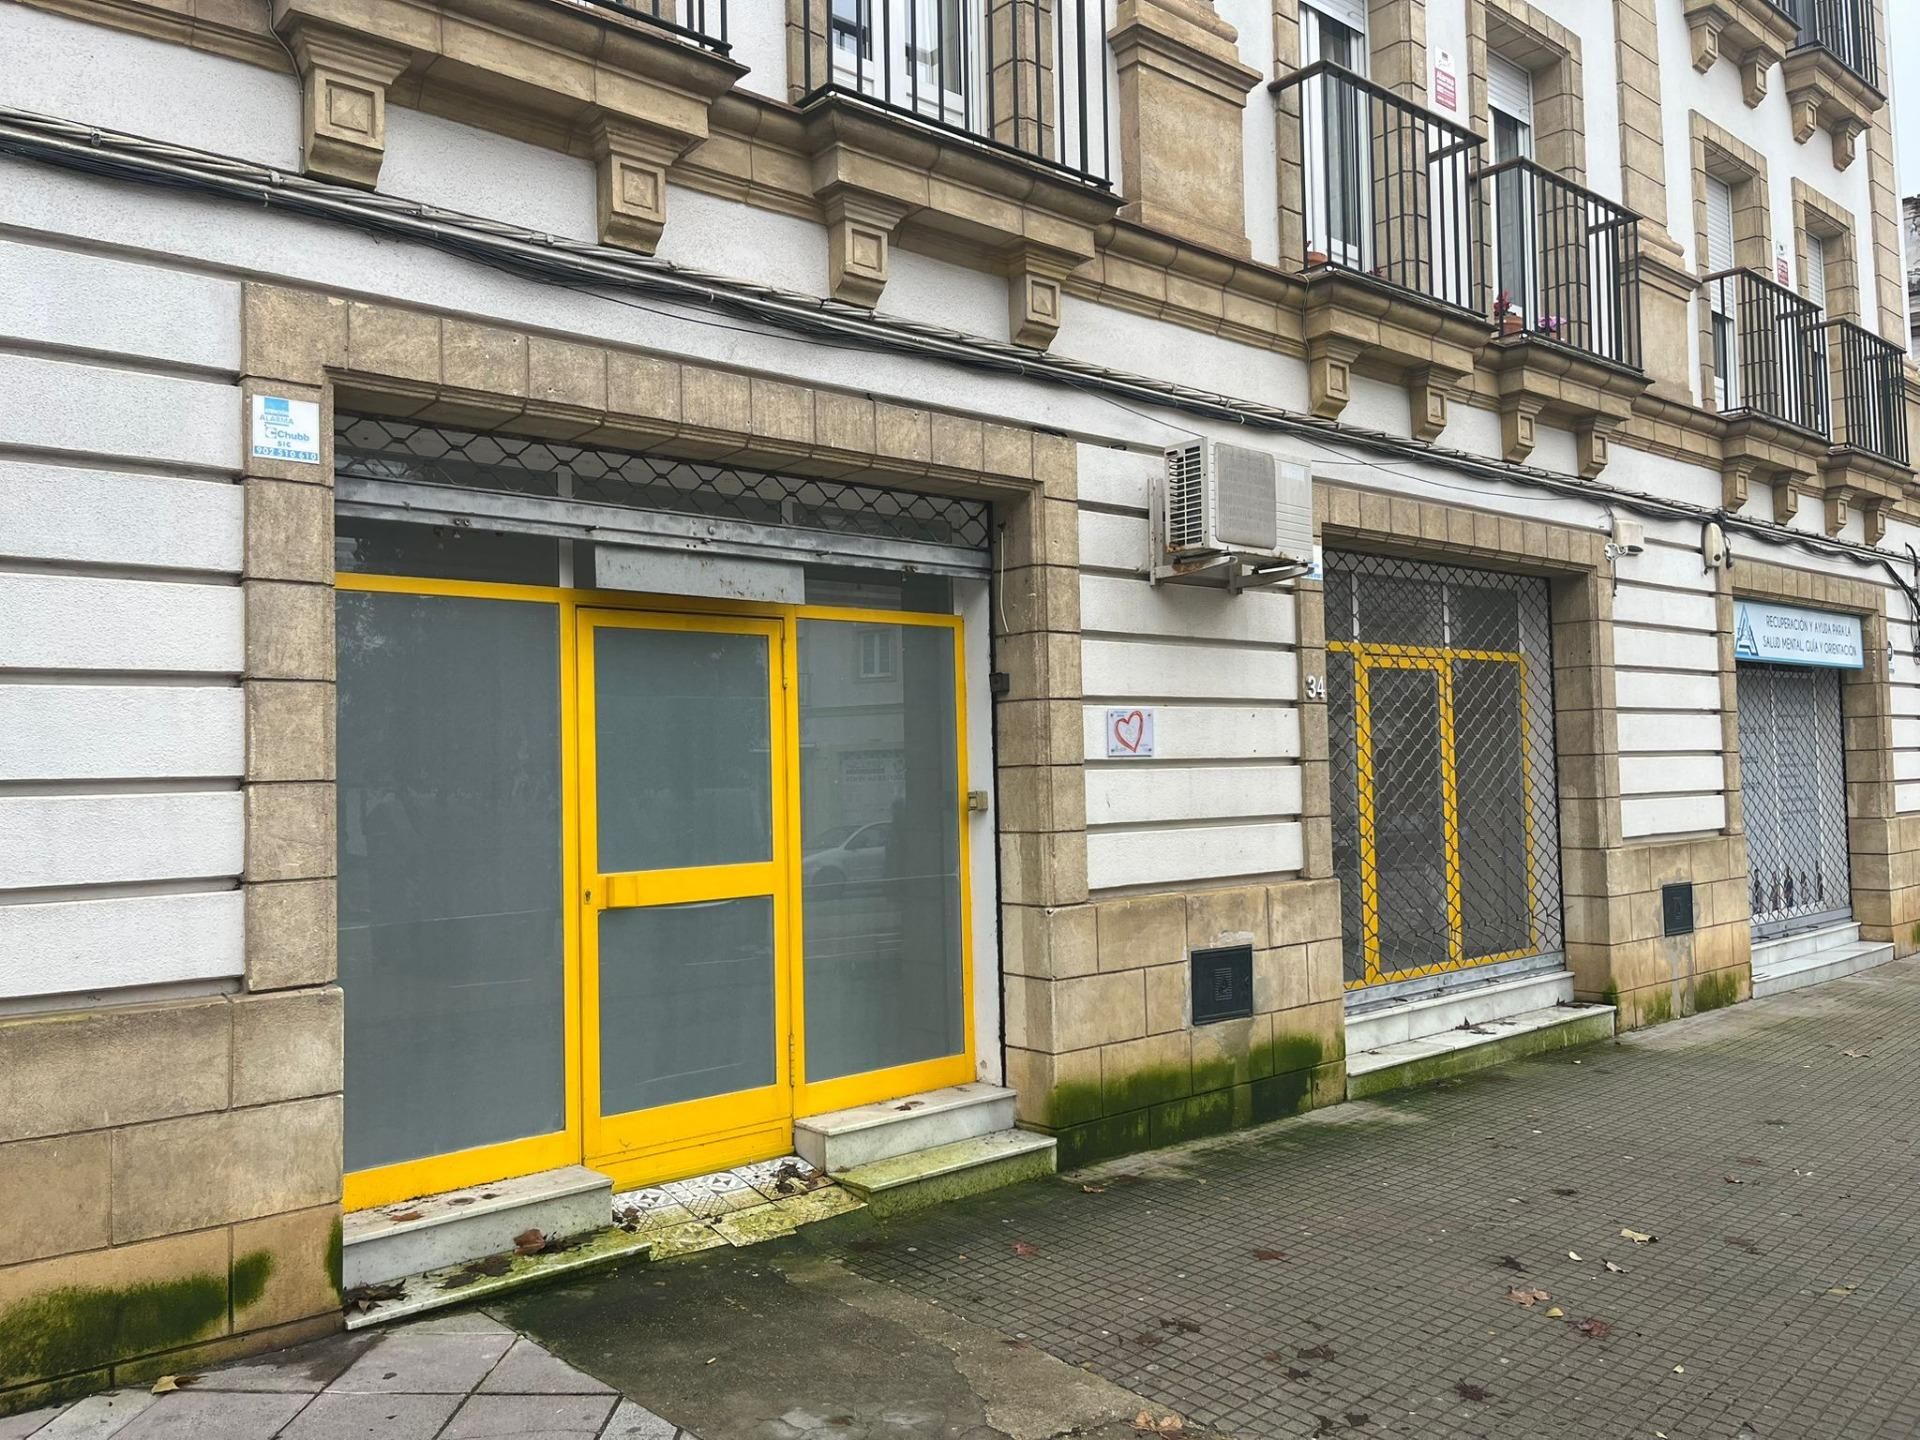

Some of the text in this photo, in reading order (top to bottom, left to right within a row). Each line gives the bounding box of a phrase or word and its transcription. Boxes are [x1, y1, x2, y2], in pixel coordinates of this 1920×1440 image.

[277, 430, 310, 442] Chubb
[256, 446, 274, 456] 902
[1765, 614, 1808, 632] RECUPERACIÓN
[1814, 621, 1831, 634] AYUDA
[1762, 635, 1781, 649] SALUD
[1307, 675, 1326, 699] 34
